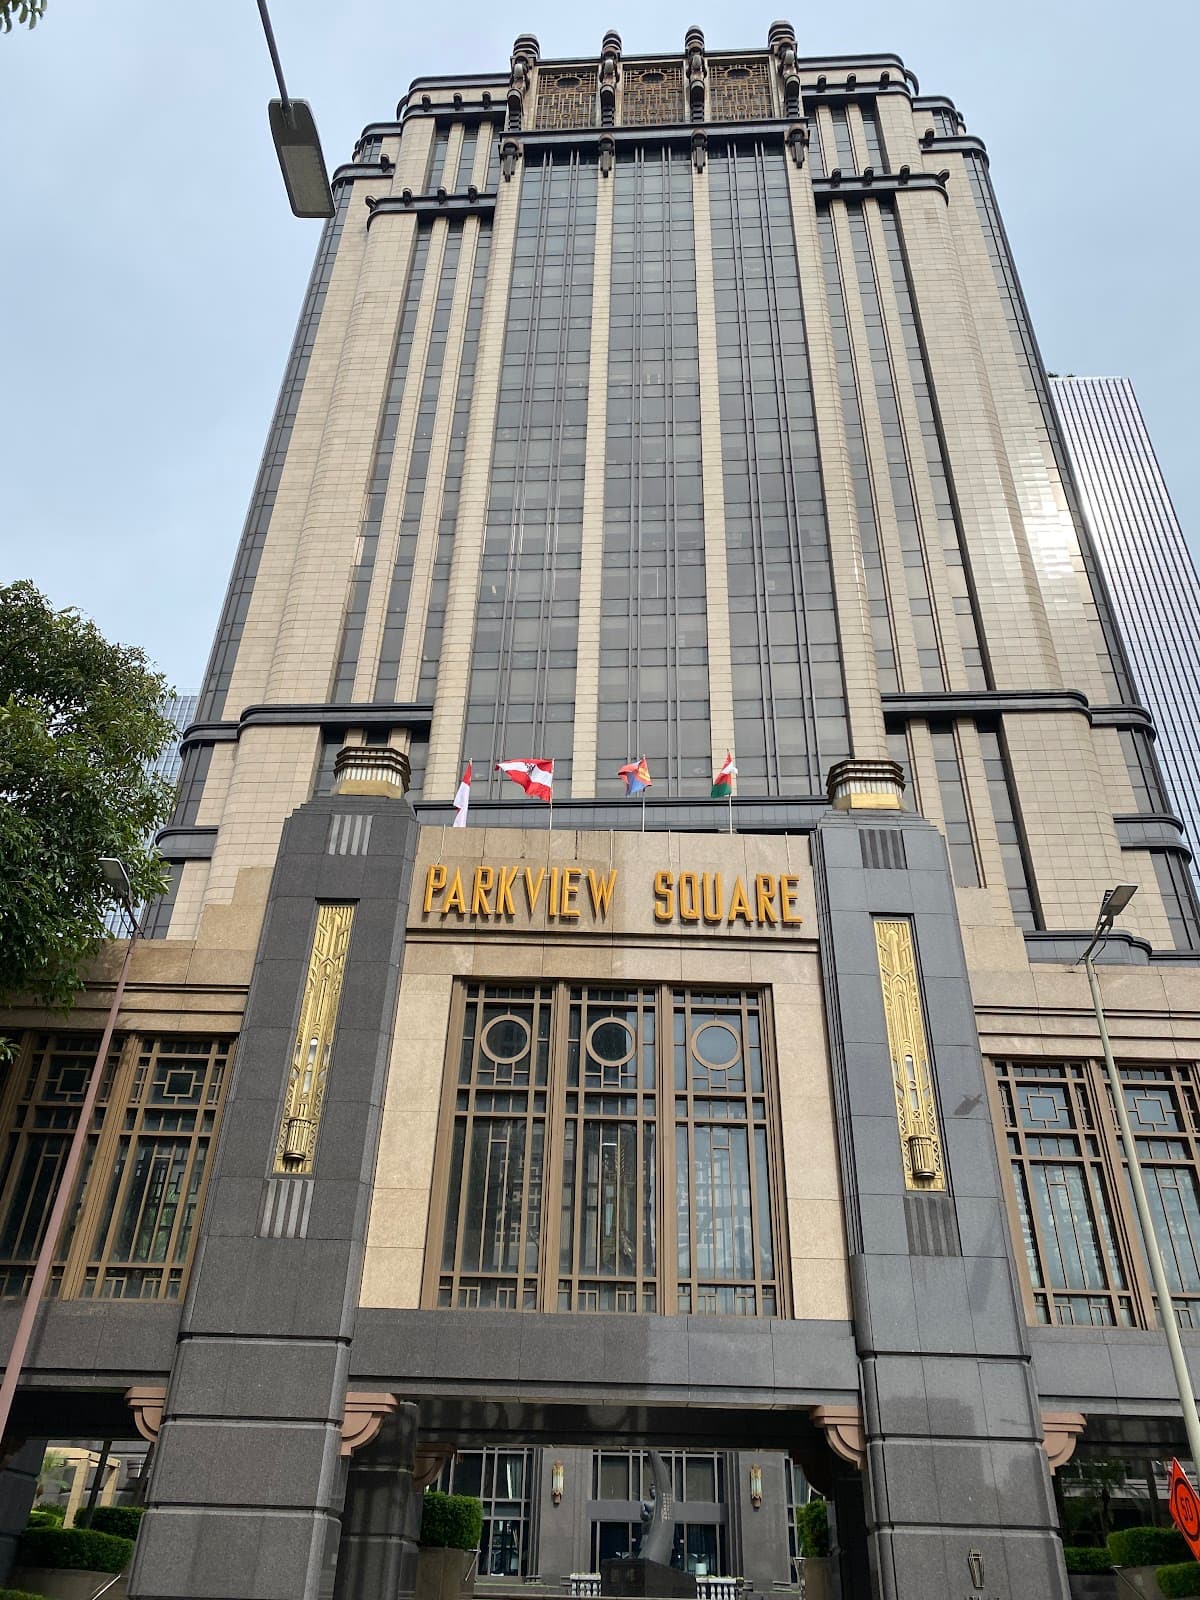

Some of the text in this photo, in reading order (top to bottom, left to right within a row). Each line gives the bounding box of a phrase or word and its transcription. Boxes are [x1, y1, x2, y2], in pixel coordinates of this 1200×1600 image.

[423, 865, 803, 924] PARKVIEW SQUARE
[1180, 1496, 1194, 1521] 50
